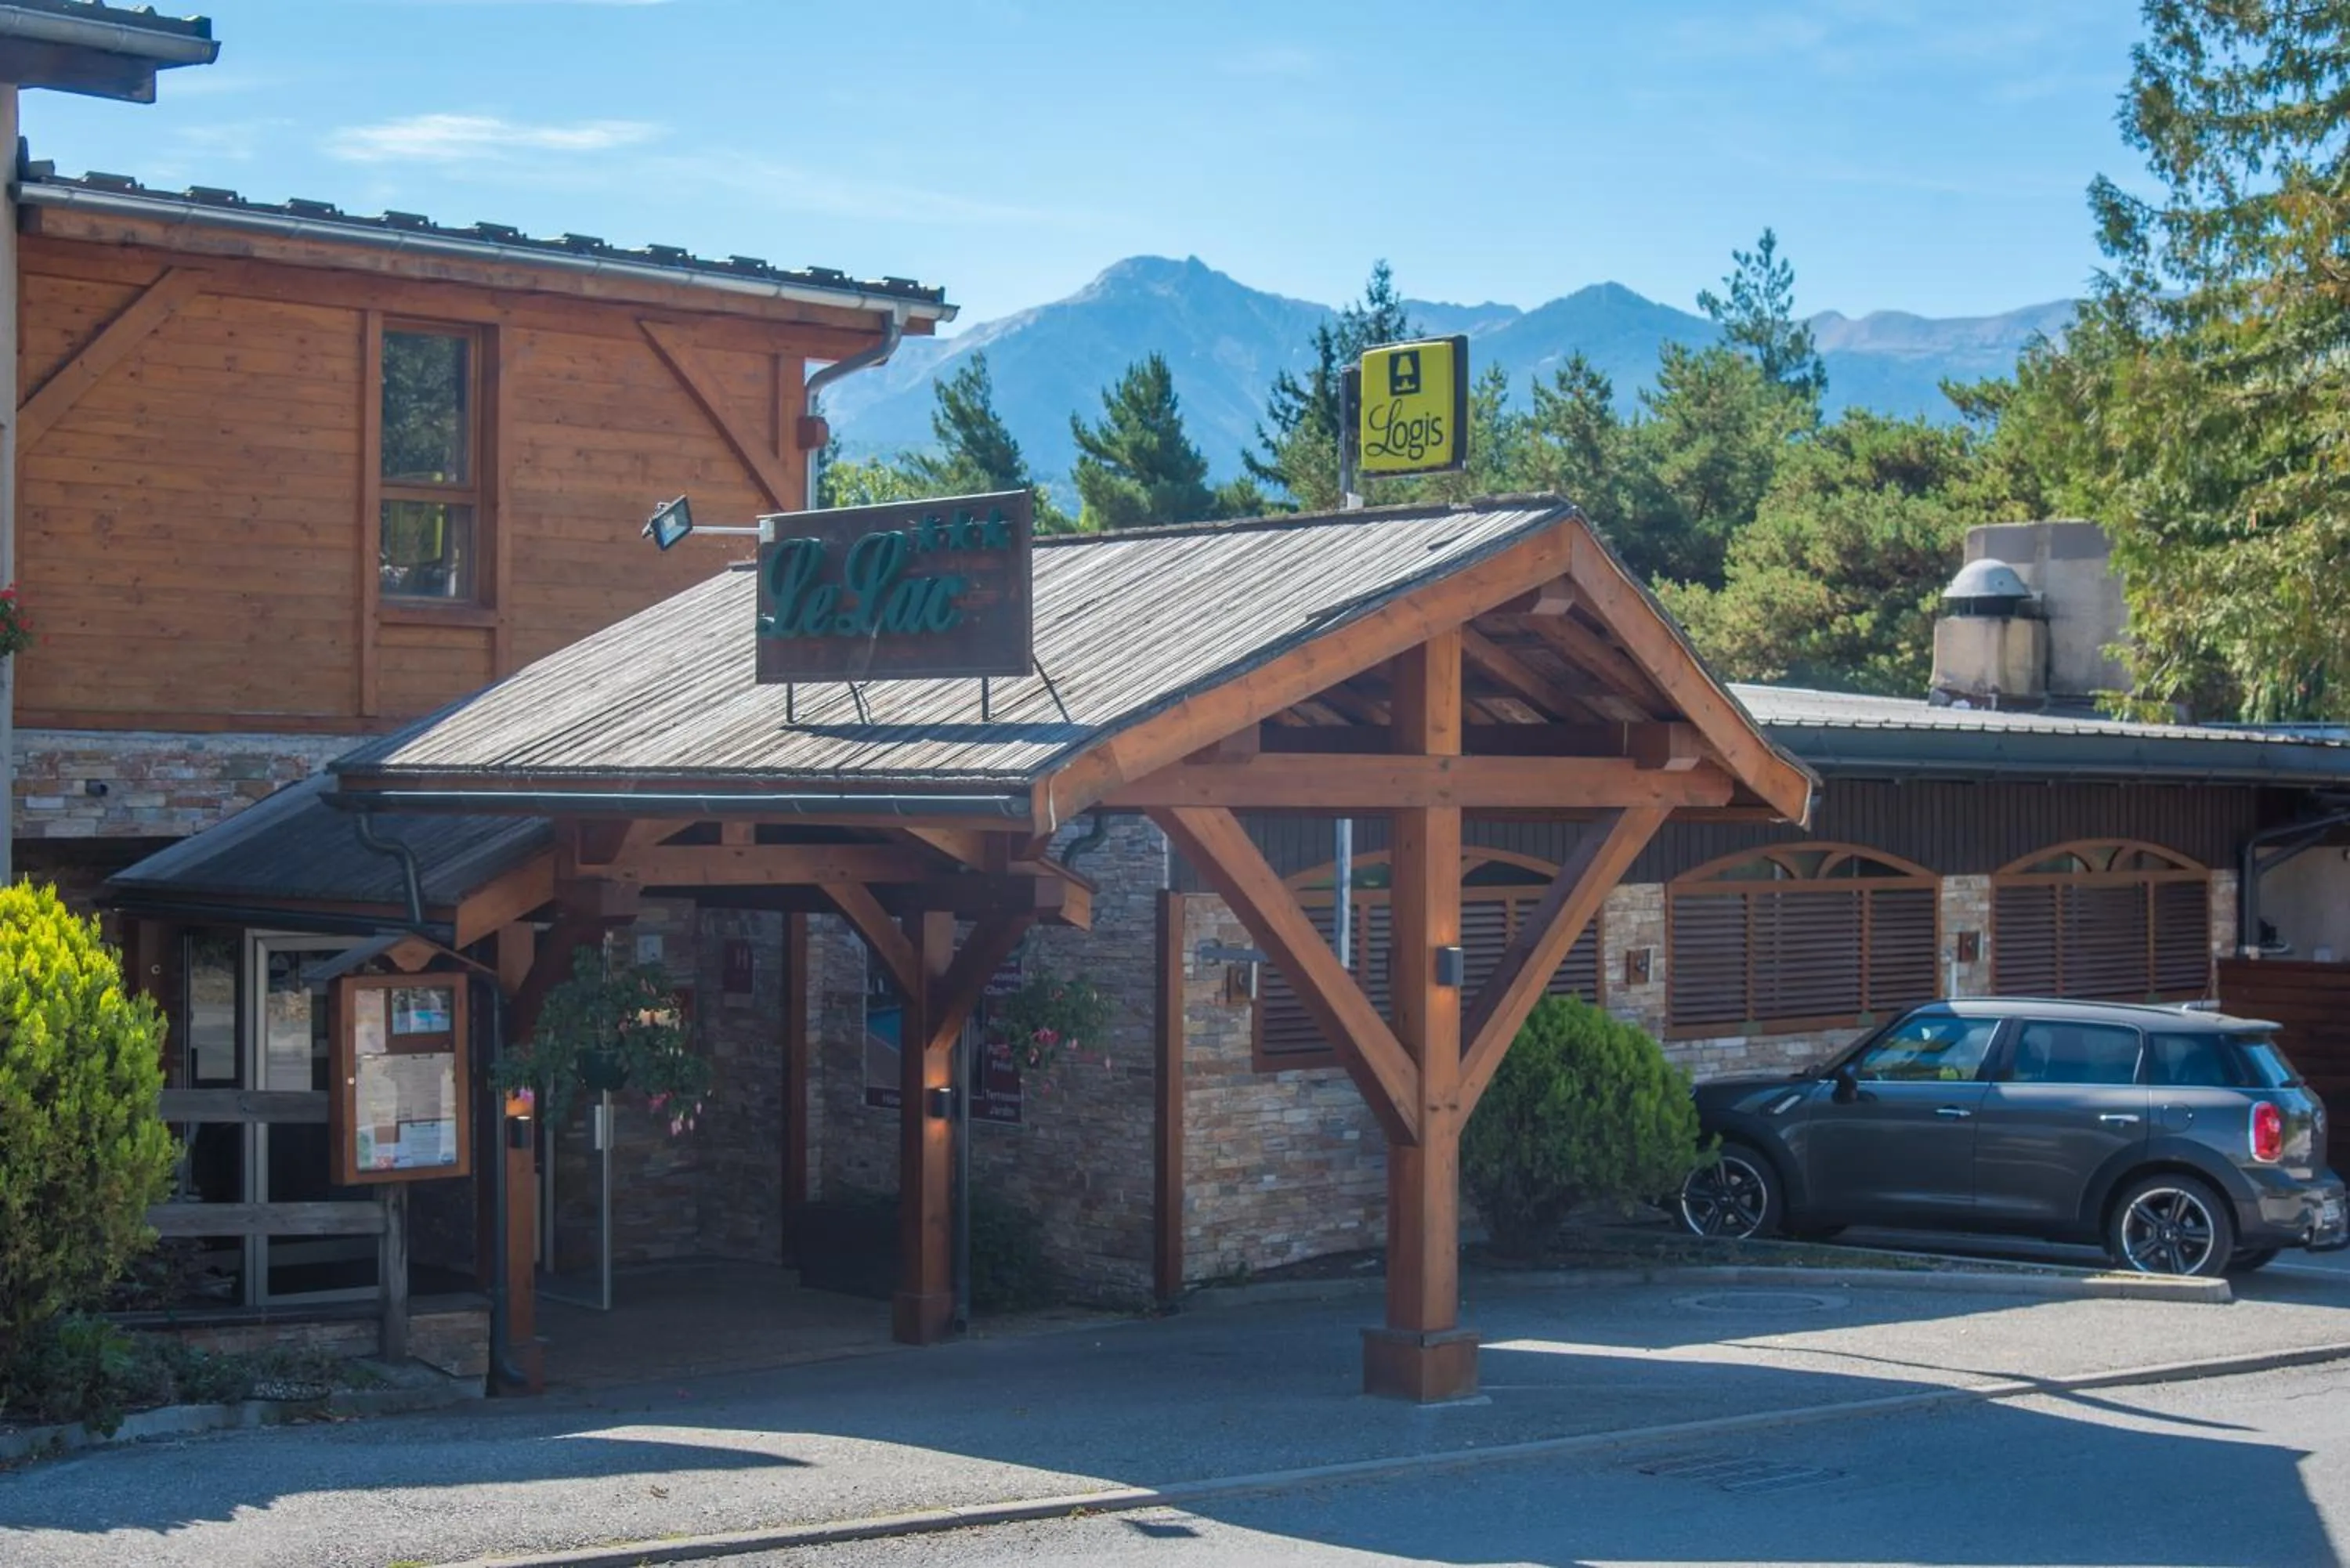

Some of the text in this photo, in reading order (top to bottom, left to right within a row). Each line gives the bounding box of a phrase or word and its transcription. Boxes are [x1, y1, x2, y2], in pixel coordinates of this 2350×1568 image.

[1365, 398, 1444, 461] Logis
[757, 530, 968, 639] Le Lac
